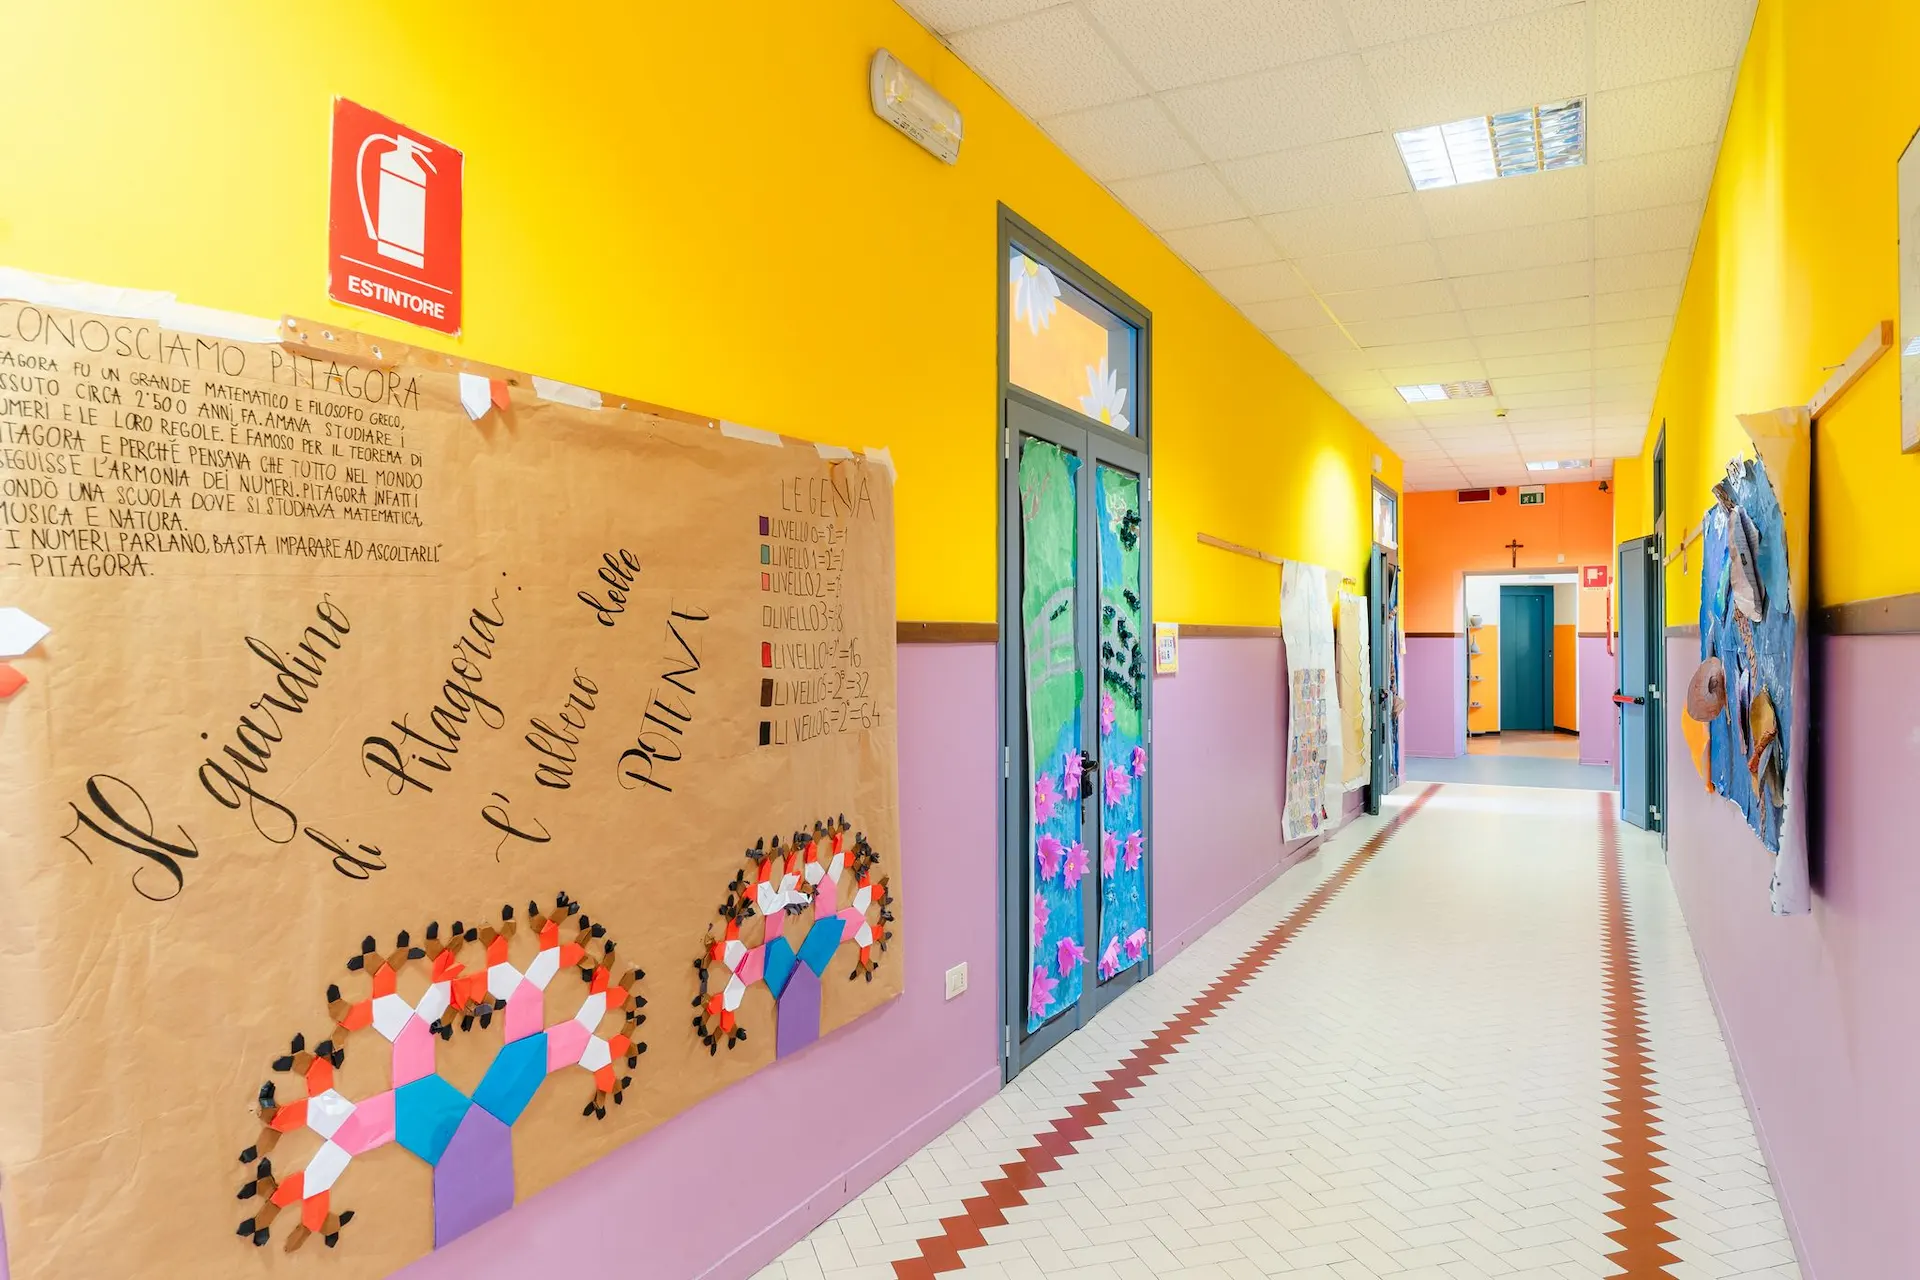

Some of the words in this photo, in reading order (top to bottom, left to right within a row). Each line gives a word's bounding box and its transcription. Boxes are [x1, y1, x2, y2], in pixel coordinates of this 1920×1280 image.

[347, 275, 445, 320] ESTINTORE
[74, 361, 91, 377] FU
[101, 368, 120, 381] UN
[129, 372, 191, 394] GRANDE
[205, 382, 288, 410] MATEMATICO
[296, 399, 303, 411] E
[309, 398, 363, 422] FILOSOFO
[370, 412, 405, 430] GRECO,
[271, 350, 420, 411] PITAGORA
[63, 403, 72, 421] E
[79, 406, 97, 426] LE
[115, 410, 153, 432] LORO
[160, 418, 224, 442] REGOLE.
[246, 428, 294, 450] FAMOSO
[302, 438, 322, 455] PER
[332, 444, 344, 457] IL
[349, 445, 402, 465] TEOREMA
[76, 381, 121, 405] CIRCA
[265, 411, 311, 434] AMAVA
[325, 422, 392, 447] STUDIARE
[94, 456, 190, 487] L'ARMONIA
[303, 481, 368, 504] PITAGORA
[101, 435, 112, 454] E
[189, 445, 251, 470] PENSAVA
[260, 455, 284, 474] CHE
[291, 459, 337, 481] TUTTO
[346, 466, 368, 484] NEL
[376, 470, 423, 489] MONDO
[69, 482, 104, 503] UNA
[117, 486, 181, 509] SCUOLA
[192, 492, 235, 512] DOVE
[247, 495, 259, 514] SI
[266, 496, 335, 519] STUDIAVA
[86, 506, 100, 527] E
[109, 508, 188, 532] NATURA.
[30, 554, 154, 577] PITAGORA.
[32, 528, 110, 552] NUMERI
[213, 533, 267, 555] BASTA
[276, 535, 341, 559] IMPARARE
[344, 539, 363, 560] AD
[525, 667, 598, 789] albero
[577, 548, 641, 627] delle
[60, 774, 199, 901] Il
[199, 593, 350, 843] giardino
[304, 827, 387, 880] di
